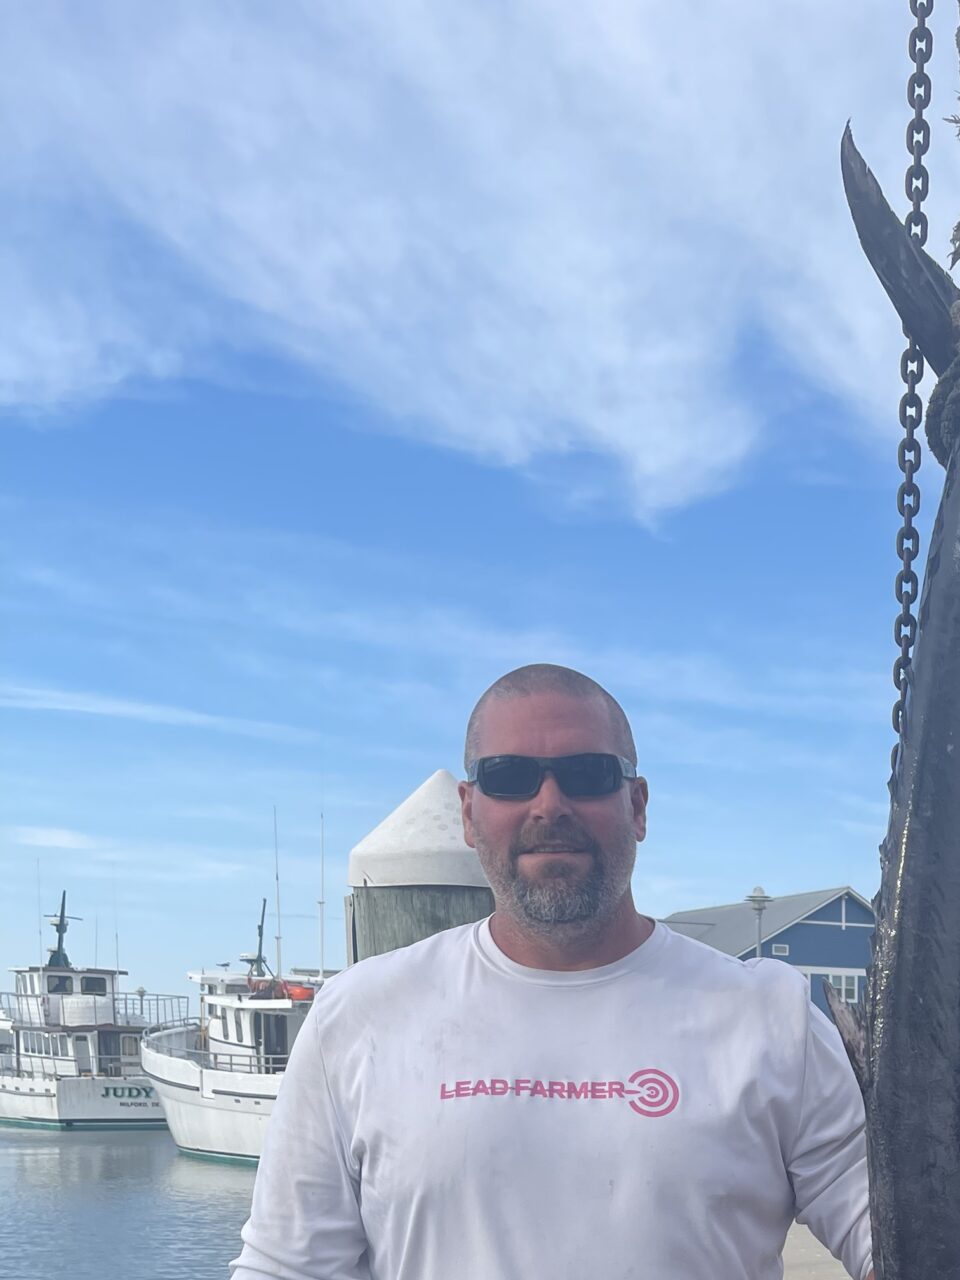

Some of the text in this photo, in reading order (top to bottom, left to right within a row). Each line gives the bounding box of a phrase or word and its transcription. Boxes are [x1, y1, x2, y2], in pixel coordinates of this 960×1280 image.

[101, 1086, 154, 1098] JUDY
[440, 1079, 625, 1100] LEAD FARMER
